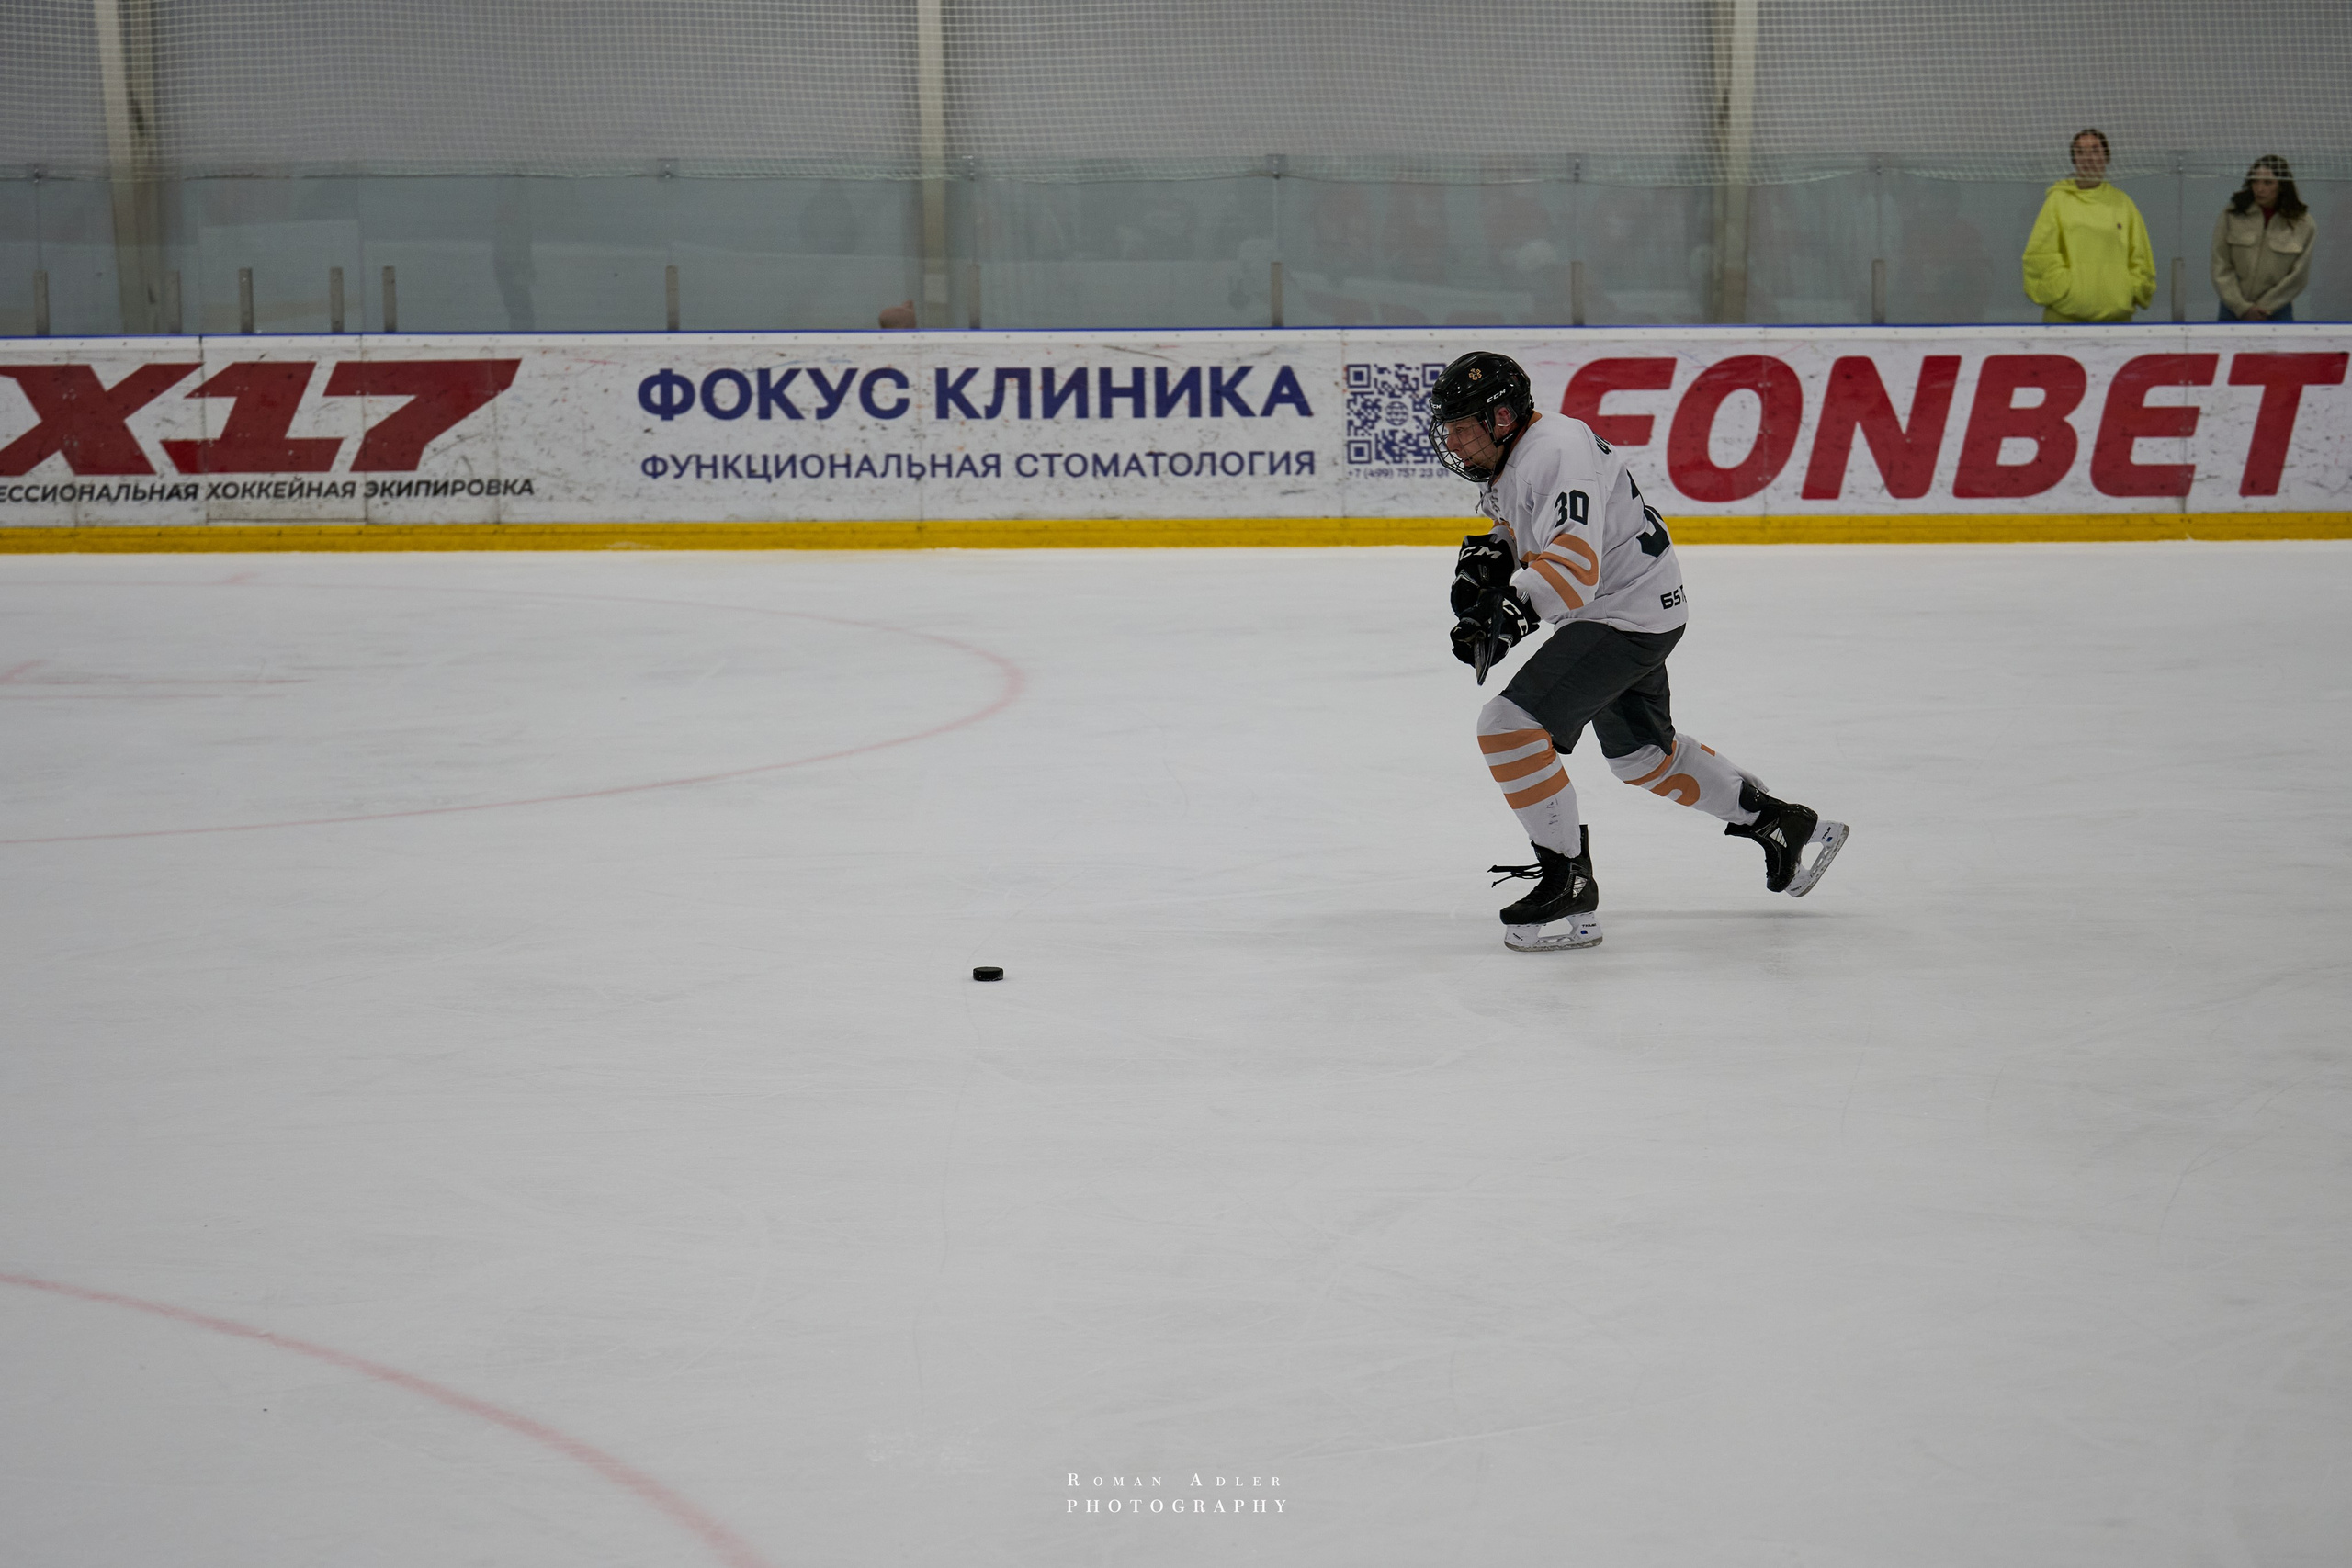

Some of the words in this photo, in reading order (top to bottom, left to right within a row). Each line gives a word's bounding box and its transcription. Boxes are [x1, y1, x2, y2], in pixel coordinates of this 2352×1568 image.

[637, 367, 910, 422] ФОКУС
[933, 364, 1314, 420] КЛИНИКА
[1487, 389, 1507, 403] CCM
[1560, 352, 2350, 502] FONBET
[640, 454, 1001, 483] ФУНКЦИОНАЛЬНАЯ
[1015, 450, 1316, 478] СТОМАТОЛОГИЯ
[206, 478, 356, 500] ХОККЕЙНАЯ
[363, 478, 535, 499] ЭКИПИРОВКА
[1554, 489, 1589, 529] 30
